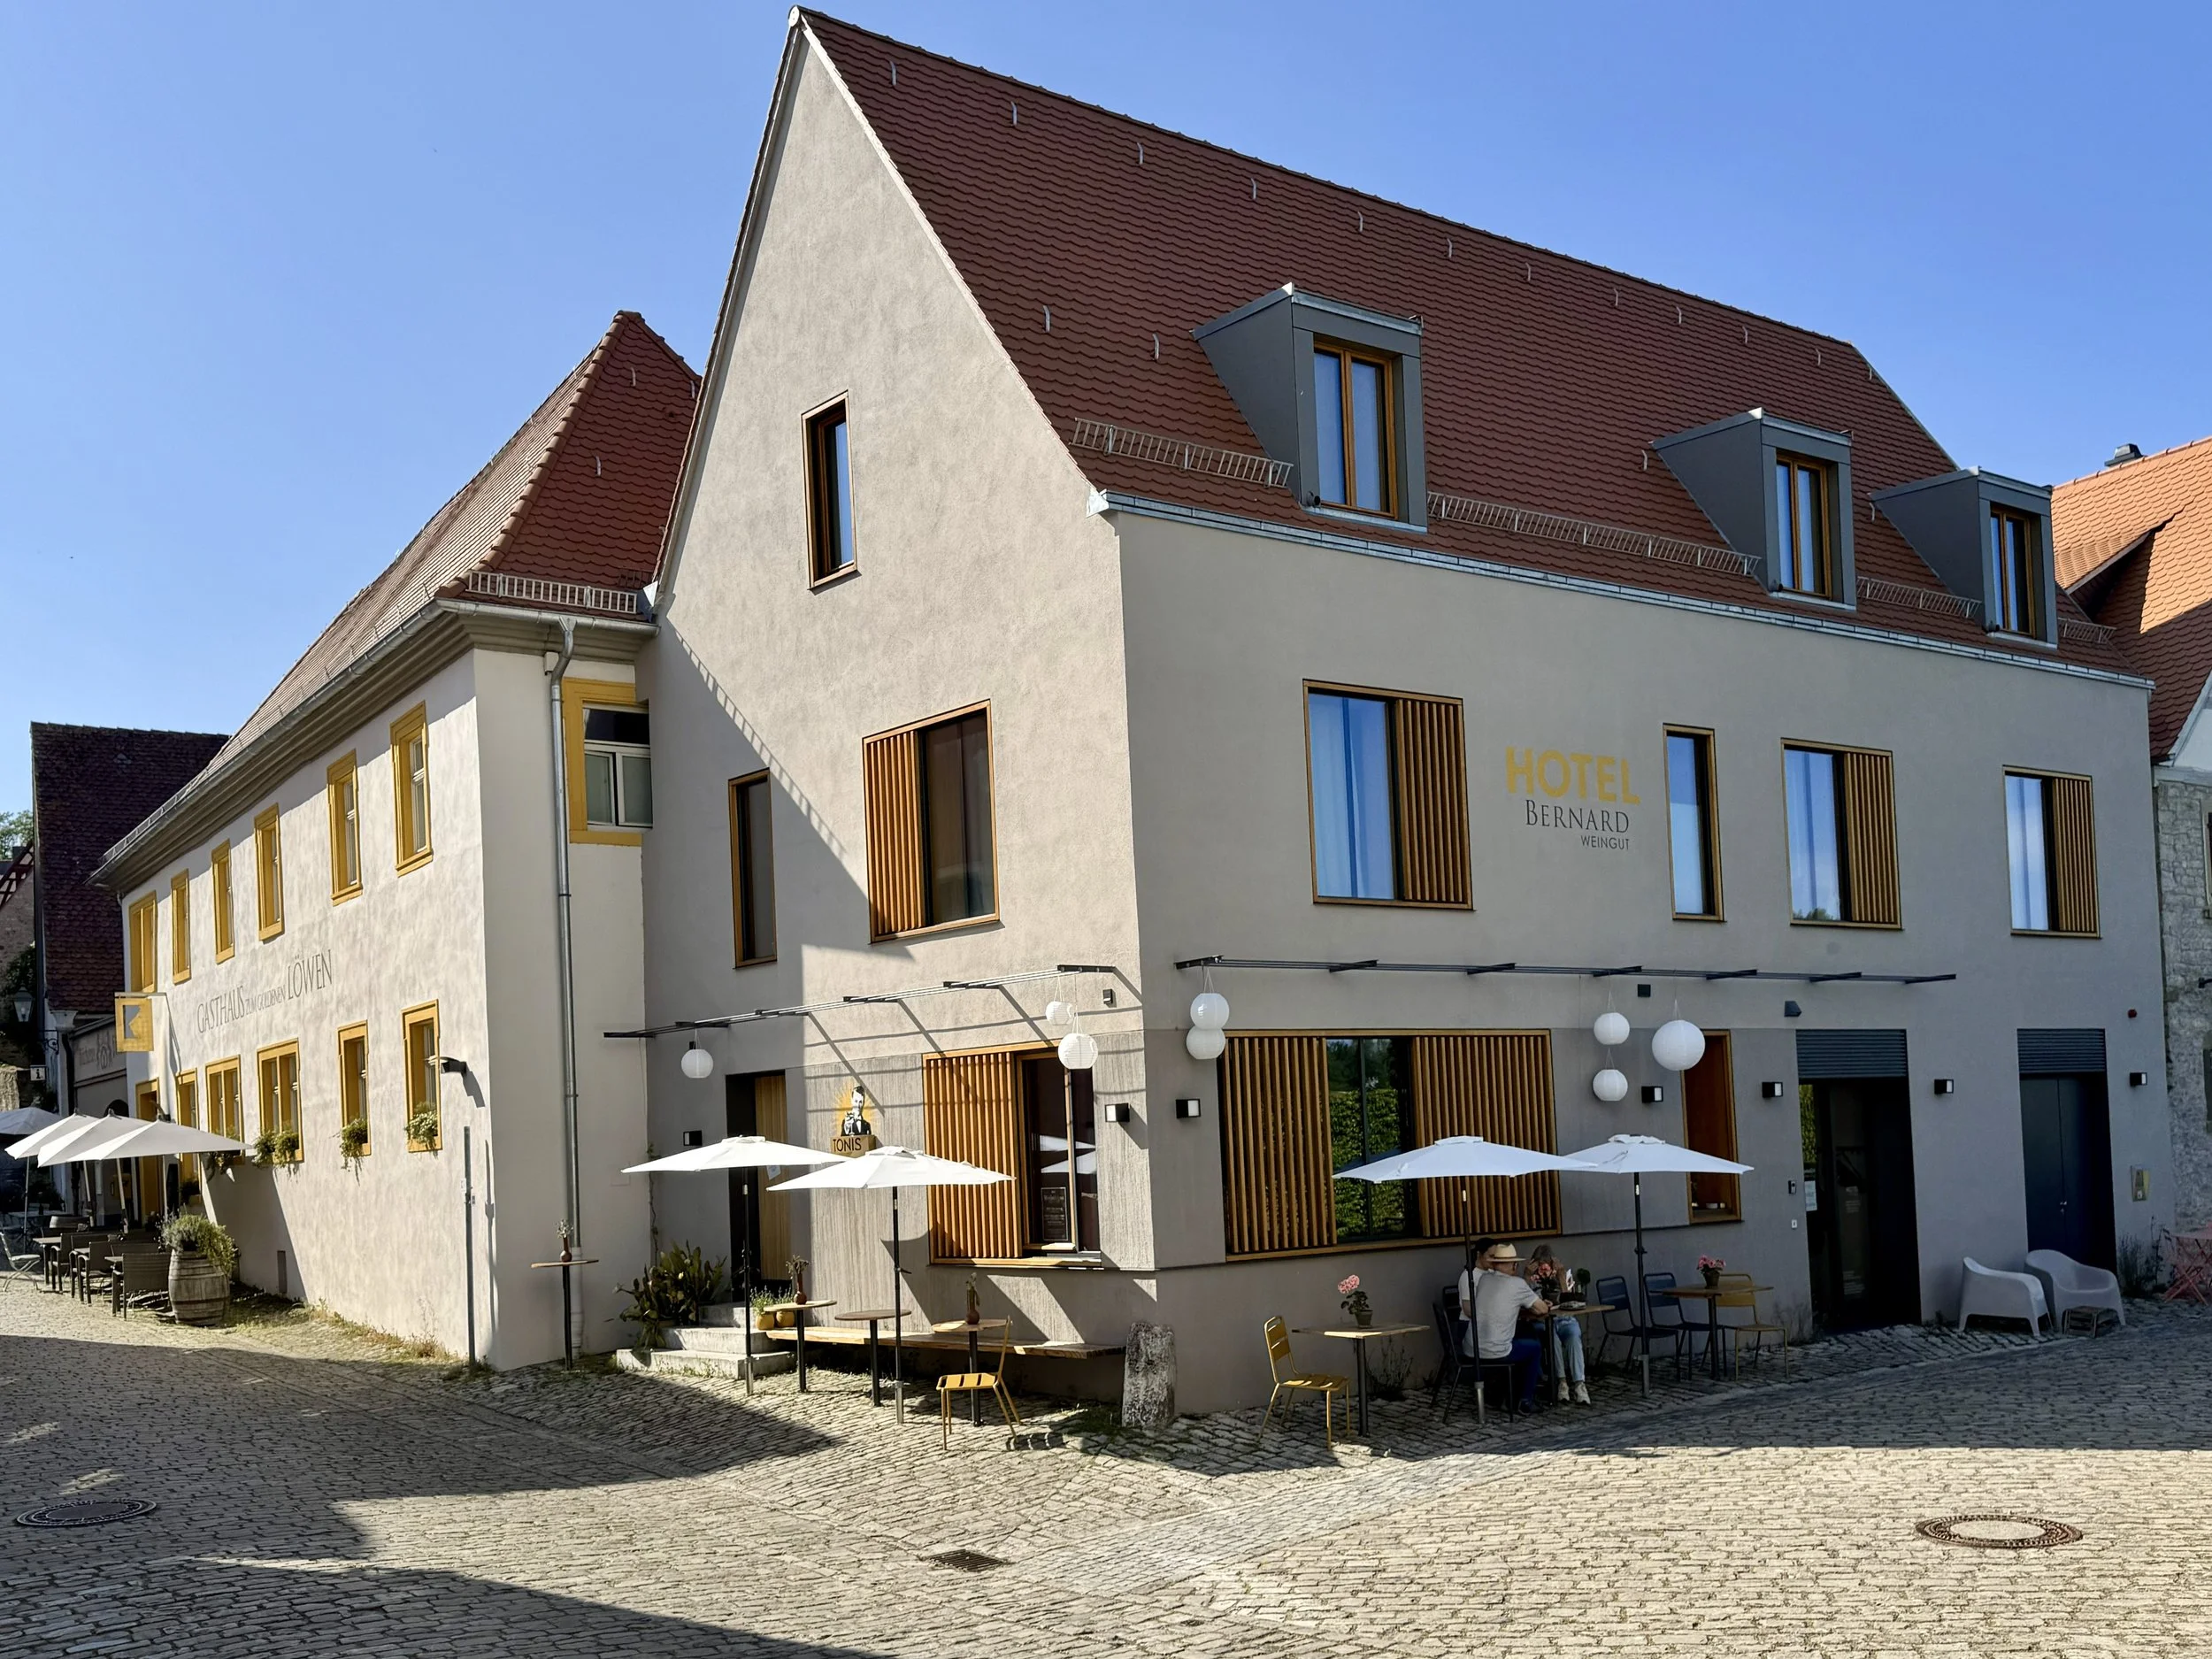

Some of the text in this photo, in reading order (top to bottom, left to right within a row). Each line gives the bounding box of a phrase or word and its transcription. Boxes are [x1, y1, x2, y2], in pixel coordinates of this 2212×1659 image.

[1505, 746, 1641, 804] HOTEL
[1525, 799, 1630, 833] BERNARD
[1580, 835, 1630, 850] WEINGUT
[197, 985, 244, 1033] GASTHAUS
[288, 949, 333, 1000] LÖWEN
[833, 1137, 862, 1152] TONIS
